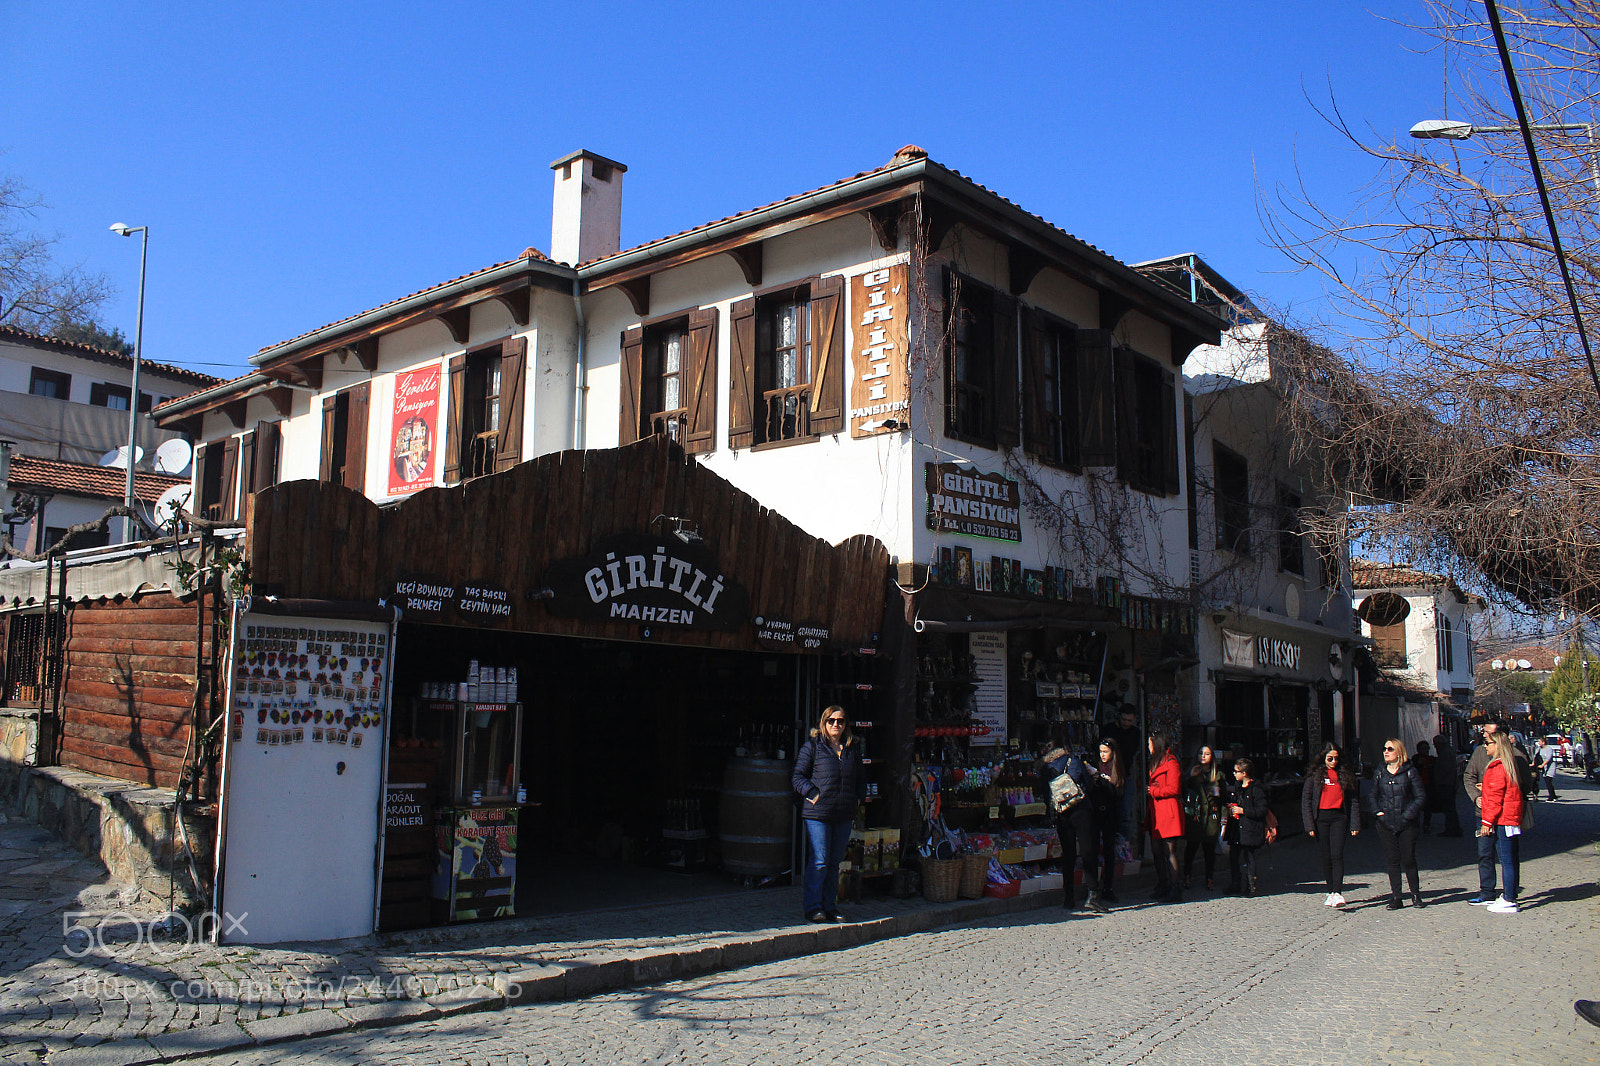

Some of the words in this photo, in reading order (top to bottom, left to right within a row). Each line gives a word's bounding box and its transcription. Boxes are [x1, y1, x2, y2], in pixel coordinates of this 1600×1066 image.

[395, 371, 438, 398] Giritli
[394, 397, 435, 414] Pansiyon
[966, 523, 972, 532] 0
[972, 523, 986, 535] 532
[986, 526, 1000, 537] 783
[1000, 529, 1008, 538] 56
[1009, 530, 1017, 539] 23
[584, 545, 724, 615] GİRİTLİ
[395, 581, 415, 595] KEÇİ
[416, 583, 454, 598] BOYNUZU
[464, 586, 480, 598] TAŞ
[482, 588, 507, 601] BASKI
[407, 597, 442, 612] PEKMEZİ
[460, 598, 490, 613] ZEYTİN
[610, 602, 694, 625] MAHZEN
[386, 805, 421, 815] ARADUT
[471, 811, 487, 821] BUZ
[386, 814, 423, 827] RÜNLERİ
[456, 827, 495, 838] KARADUT
[495, 825, 517, 836] SUYU
